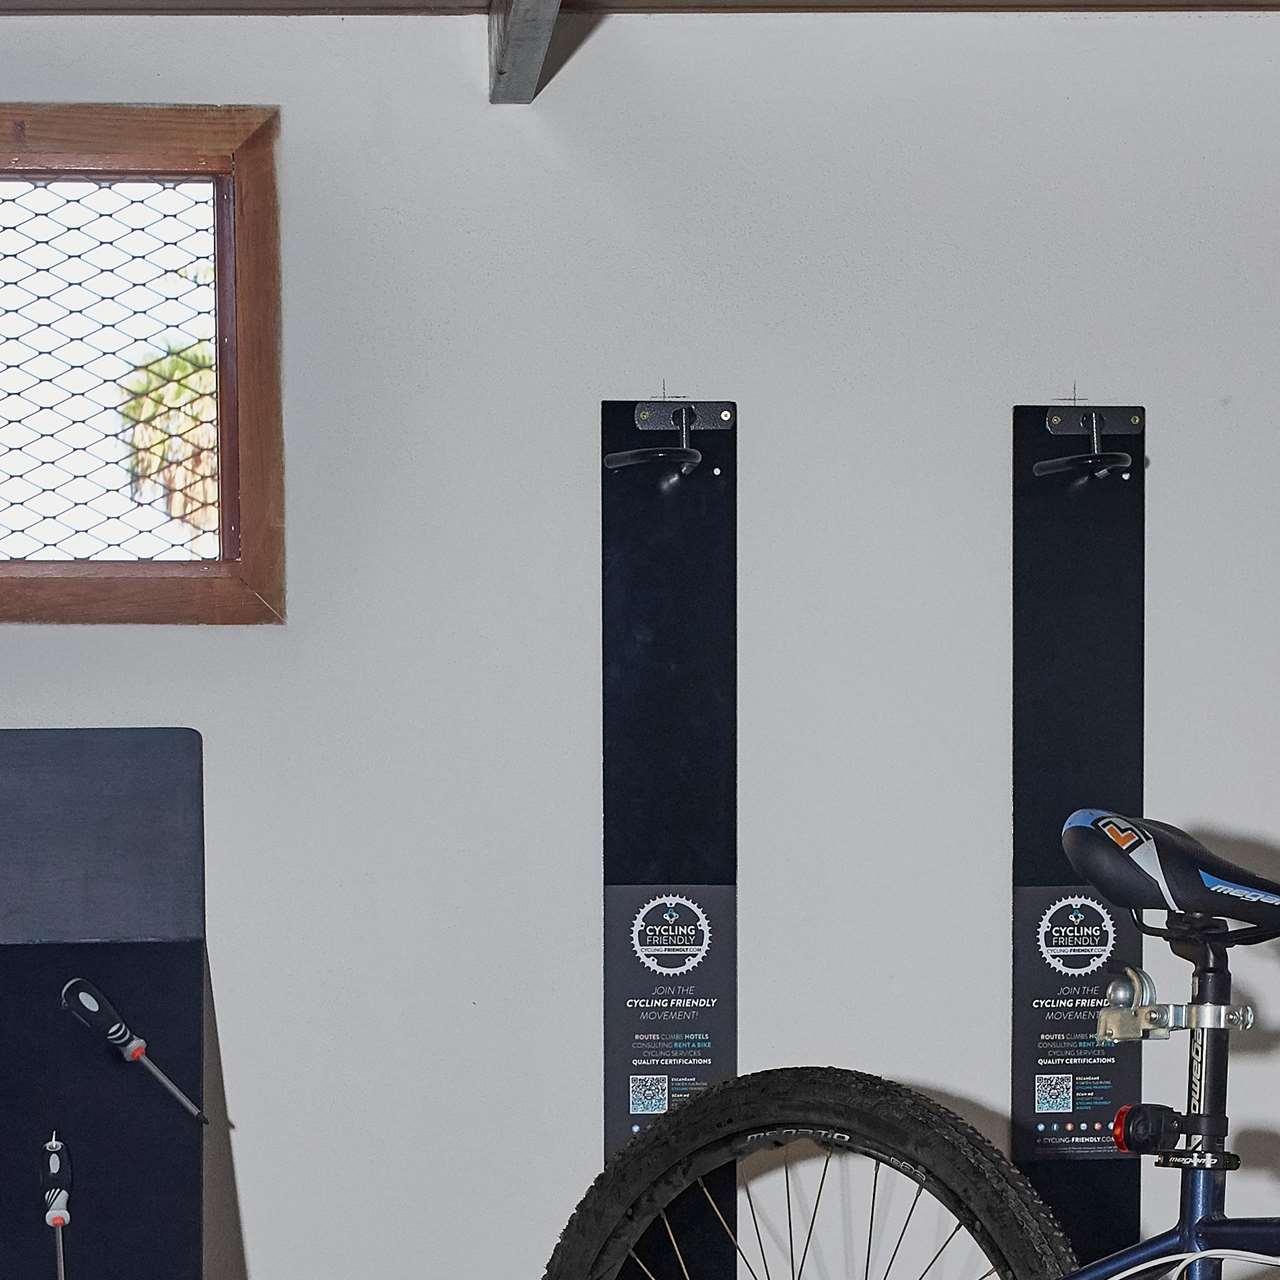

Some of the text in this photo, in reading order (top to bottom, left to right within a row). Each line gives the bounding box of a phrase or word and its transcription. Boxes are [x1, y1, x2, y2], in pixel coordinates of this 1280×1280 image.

[646, 925, 696, 936] CYCLING
[1051, 926, 1100, 936] CYCLING
[646, 935, 696, 945] FRIENDLY
[1052, 936, 1100, 946] FRIENDLY
[652, 985, 695, 995] JOIN THE
[1057, 985, 1099, 996] JOIN THE
[626, 998, 717, 1008] CYCLING FRIENDLY
[1032, 999, 1110, 1008] CYCLING FRIEND
[639, 1011, 699, 1020] MOVEMENT!
[631, 1058, 659, 1066] QUALITY
[1037, 1057, 1116, 1066] QUALITY CERTIFICATIONS
[1190, 1028, 1202, 1114] egamo
